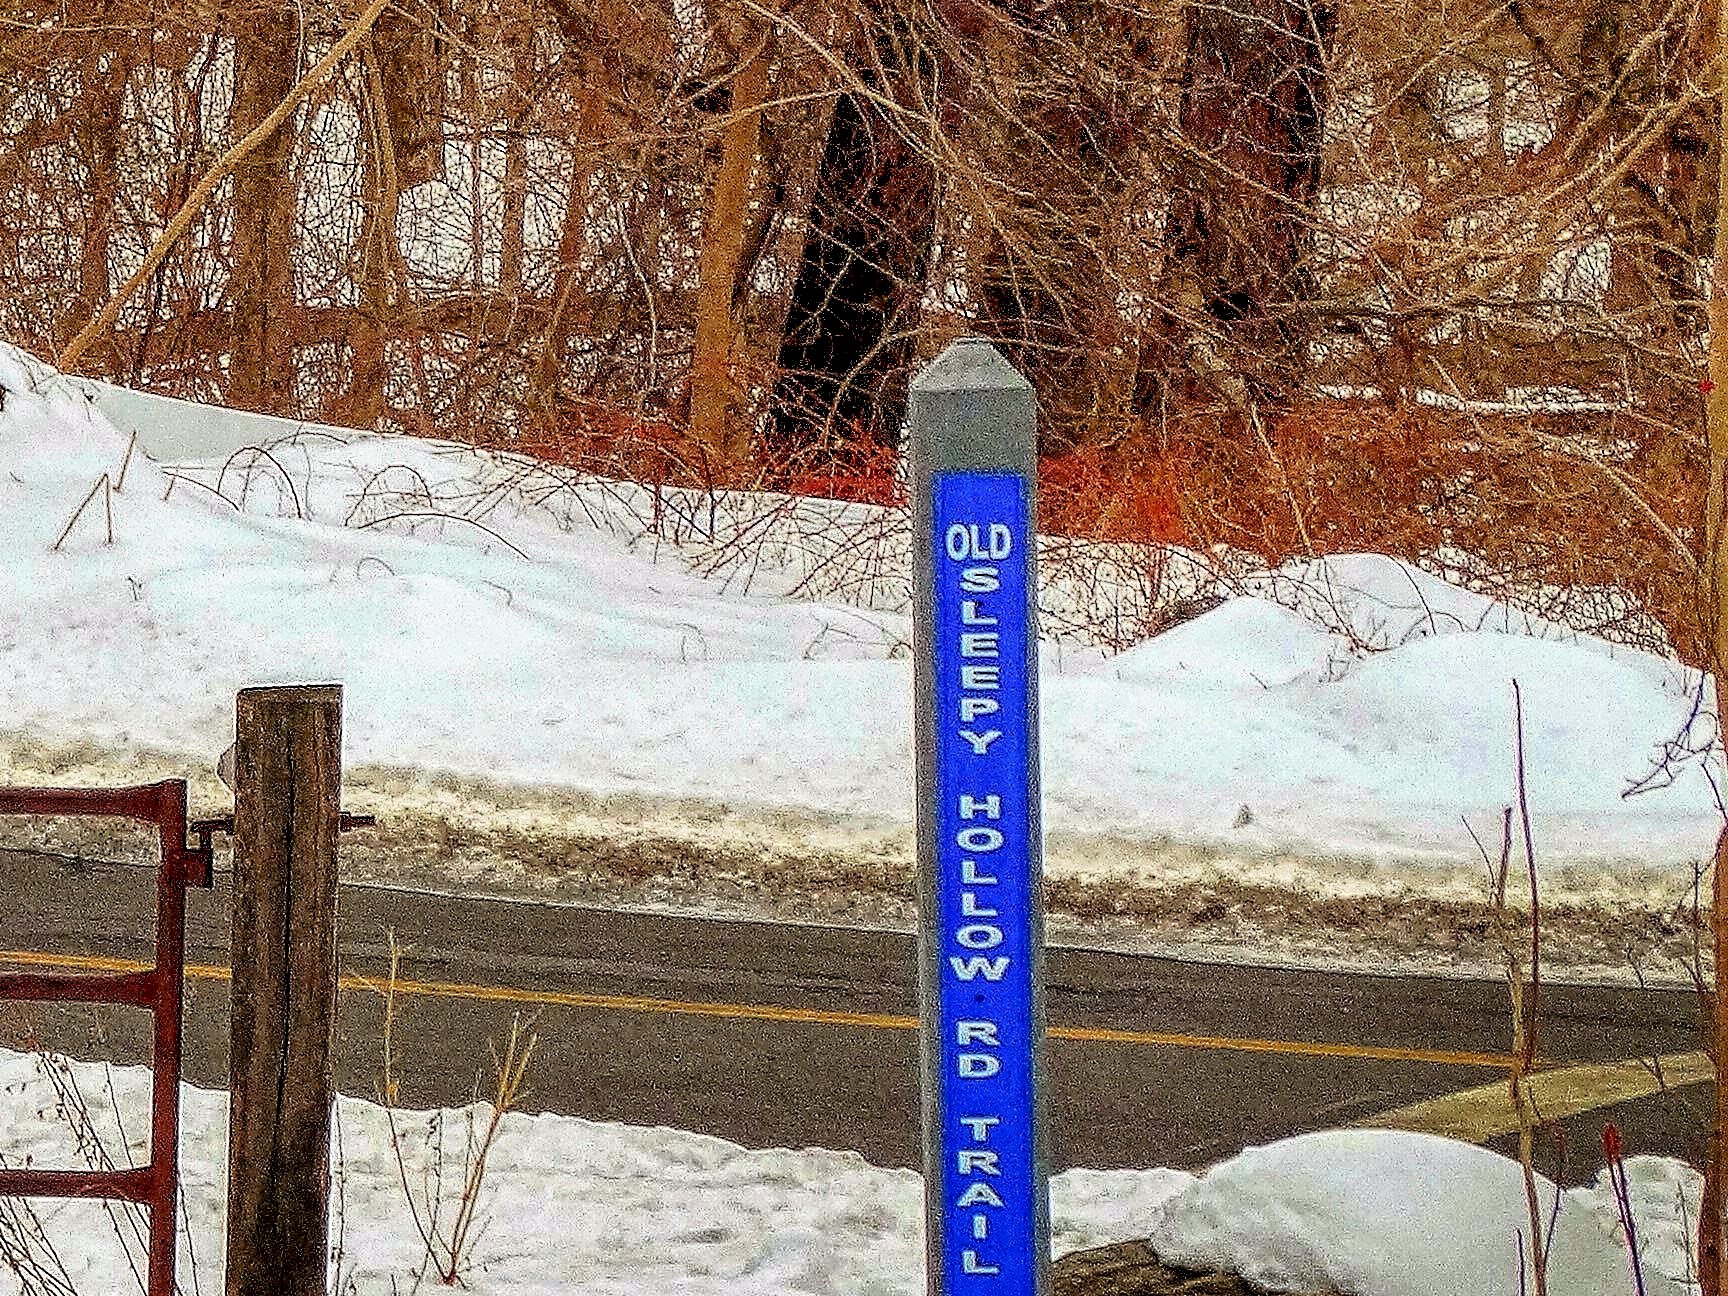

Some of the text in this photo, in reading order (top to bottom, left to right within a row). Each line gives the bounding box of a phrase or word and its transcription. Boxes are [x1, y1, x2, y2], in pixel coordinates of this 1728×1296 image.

[945, 523, 1011, 1274] OLD SLEEPY HOLLOW RD TRAIL
